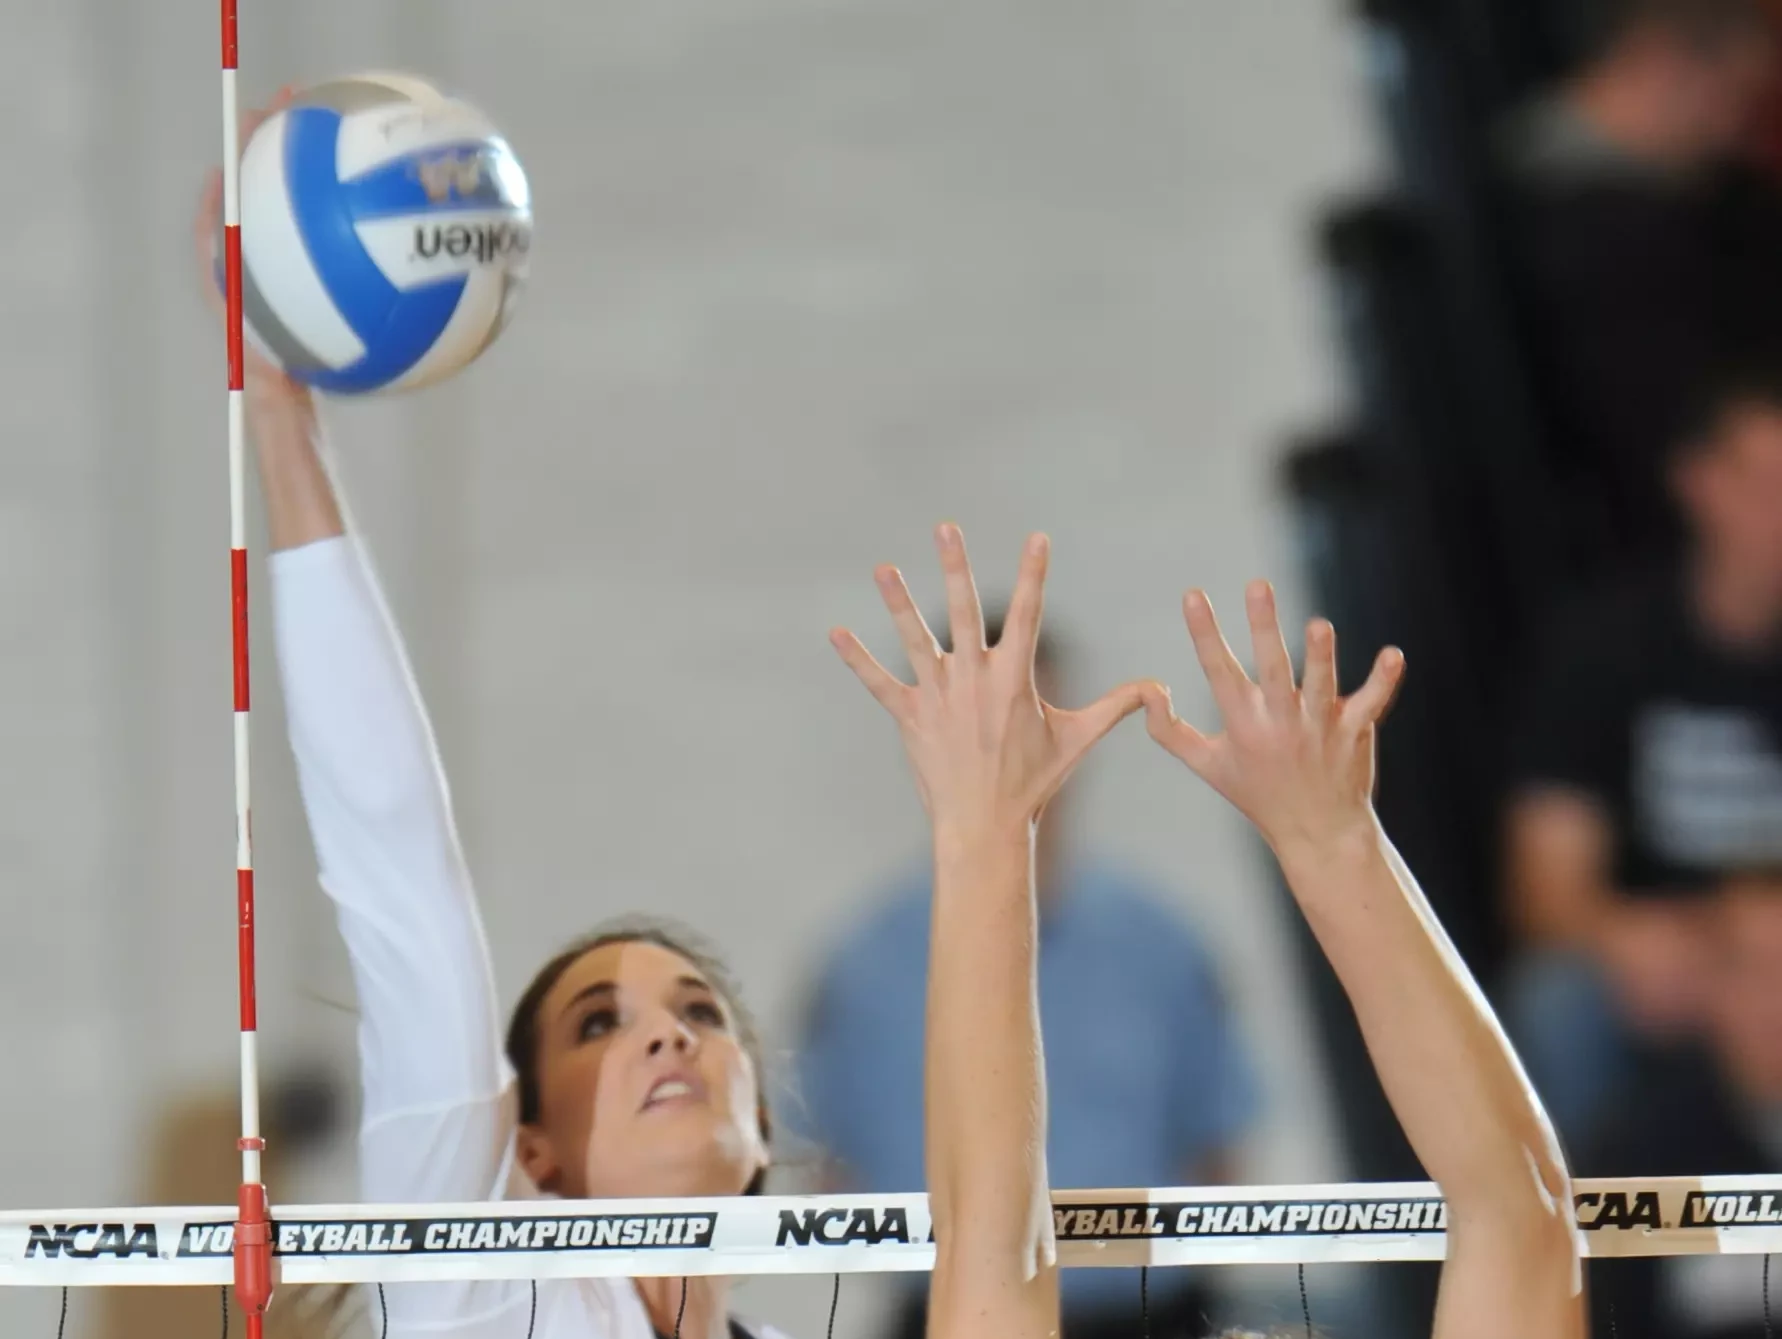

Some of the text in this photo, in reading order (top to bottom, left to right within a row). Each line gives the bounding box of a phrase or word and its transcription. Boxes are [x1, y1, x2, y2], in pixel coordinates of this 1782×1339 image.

[24, 1223, 159, 1258] NCAA
[188, 1223, 413, 1253] VOEYBALL
[423, 1216, 711, 1251] CHAMPIONSHIP
[775, 1207, 910, 1247] NCAA
[1574, 1191, 1662, 1230] CAA
[1691, 1194, 1782, 1224] VOLL
